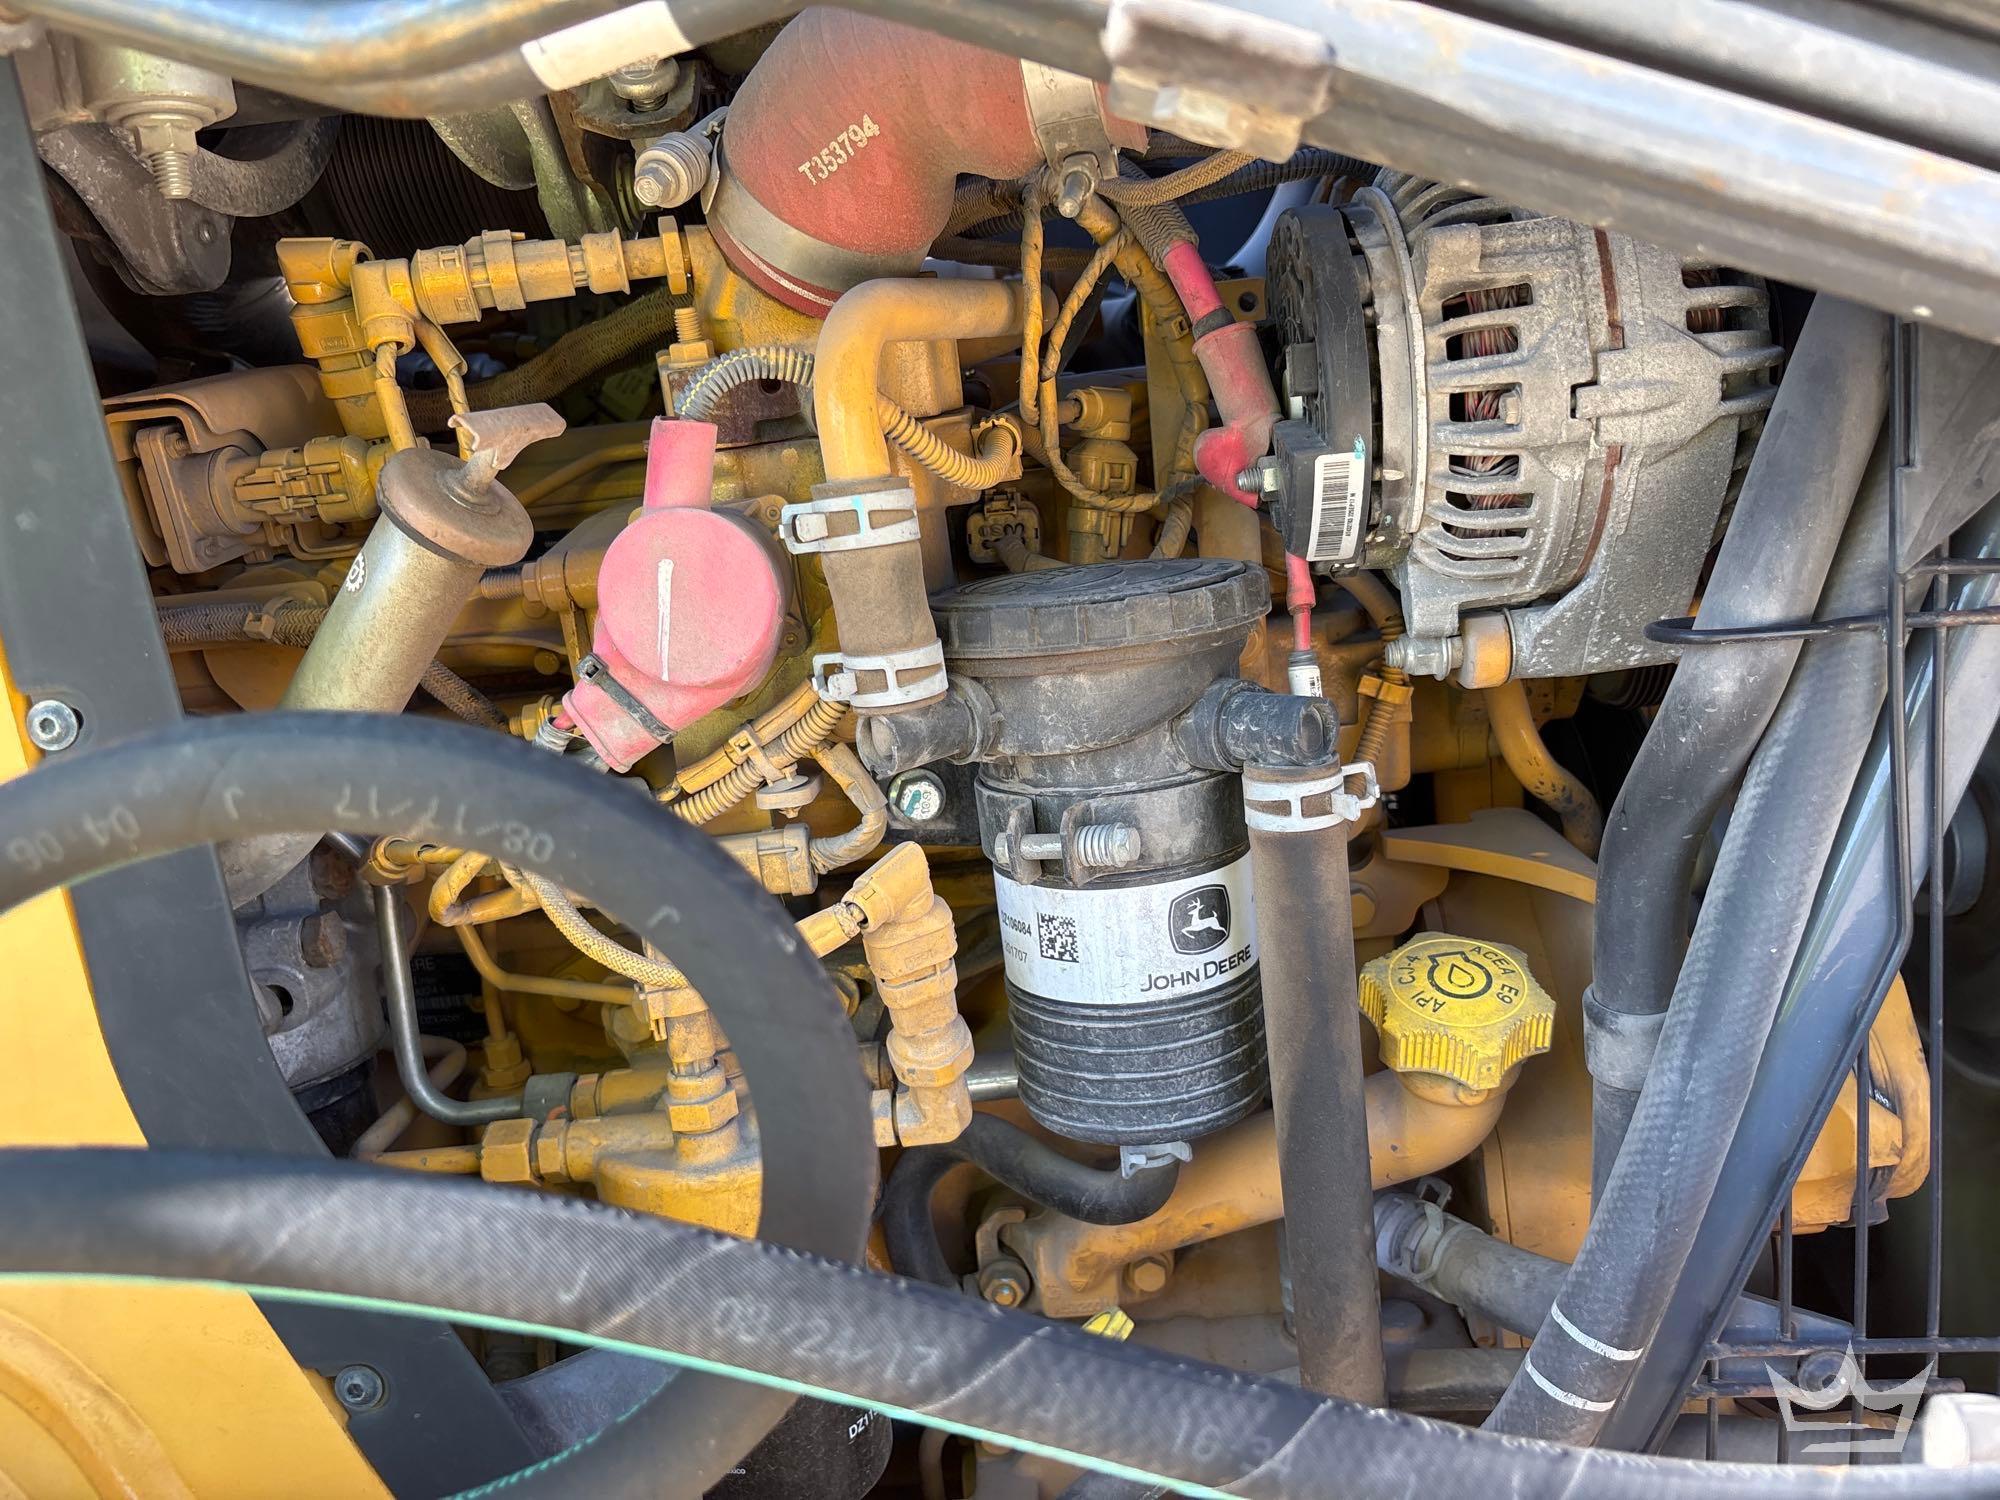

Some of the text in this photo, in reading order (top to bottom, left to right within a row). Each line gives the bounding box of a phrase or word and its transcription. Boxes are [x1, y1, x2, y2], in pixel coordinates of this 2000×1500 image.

[798, 112, 880, 186] T353794
[1140, 943, 1252, 993] JOHN DEERE
[1399, 955, 1446, 1013] API CJ-4
[1470, 946, 1520, 1005] ACEA E9
